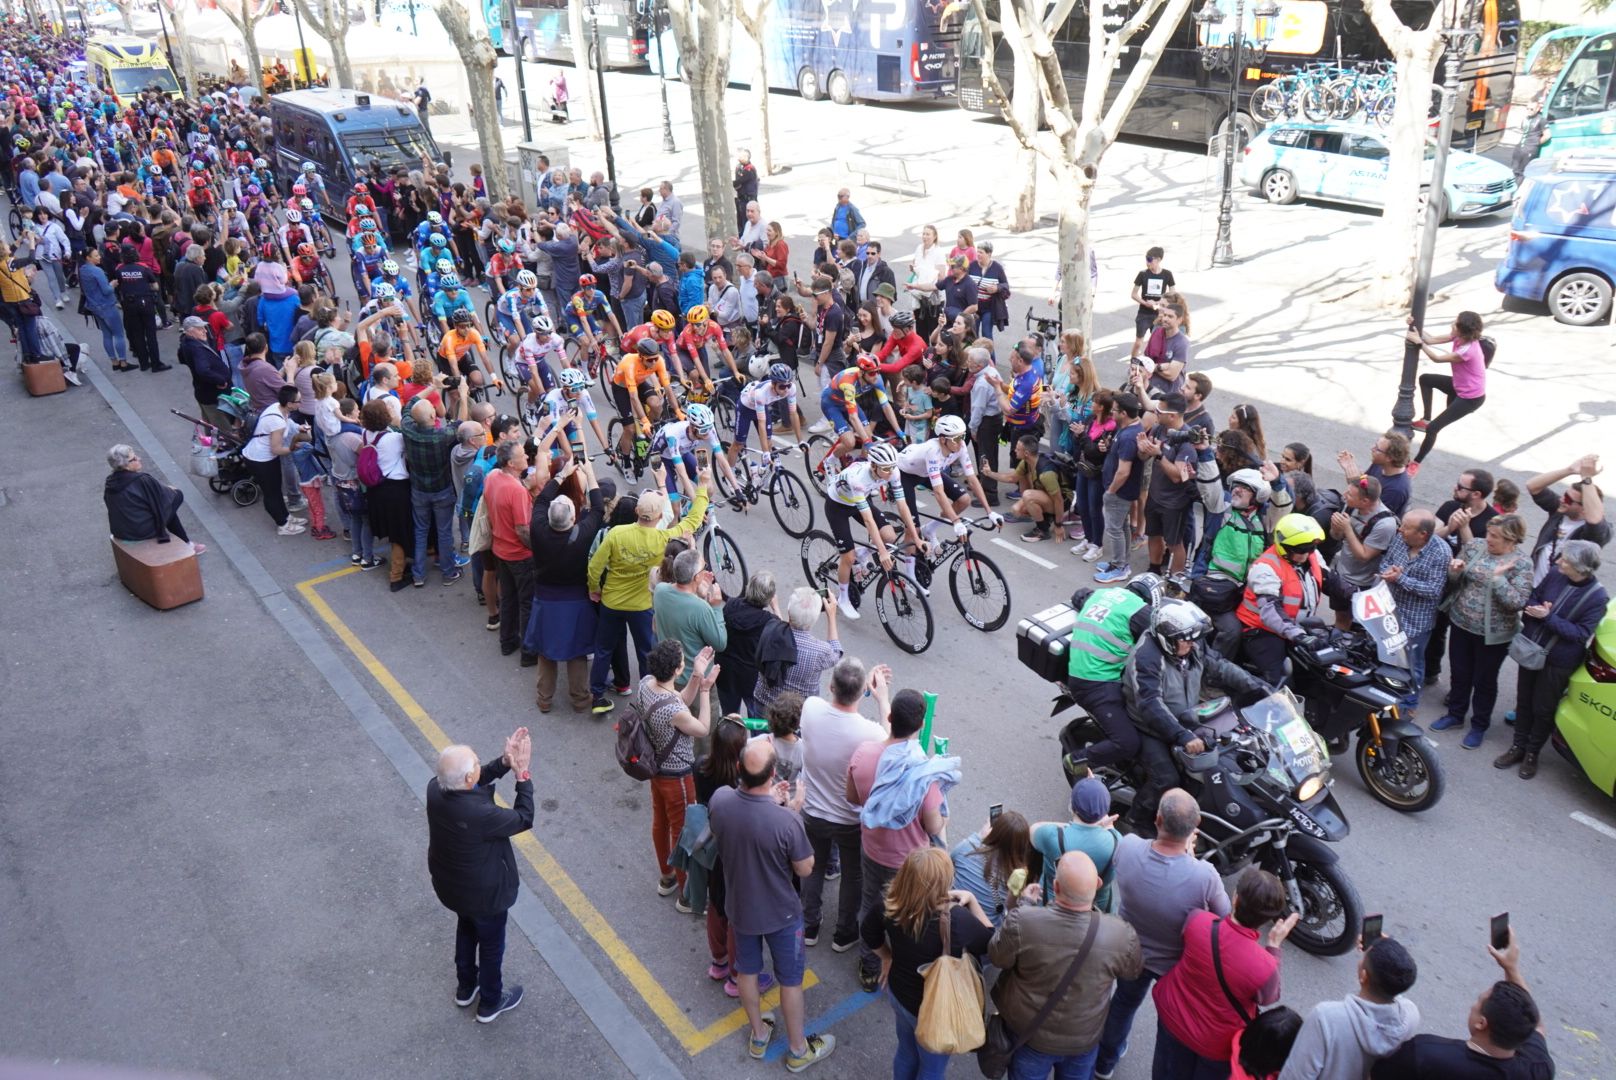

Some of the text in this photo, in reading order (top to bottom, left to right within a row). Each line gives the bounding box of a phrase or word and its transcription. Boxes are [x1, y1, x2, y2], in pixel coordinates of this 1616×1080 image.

[1349, 169, 1387, 180] ASTAN
[1083, 604, 1110, 622] 24
[1363, 594, 1384, 619] A
